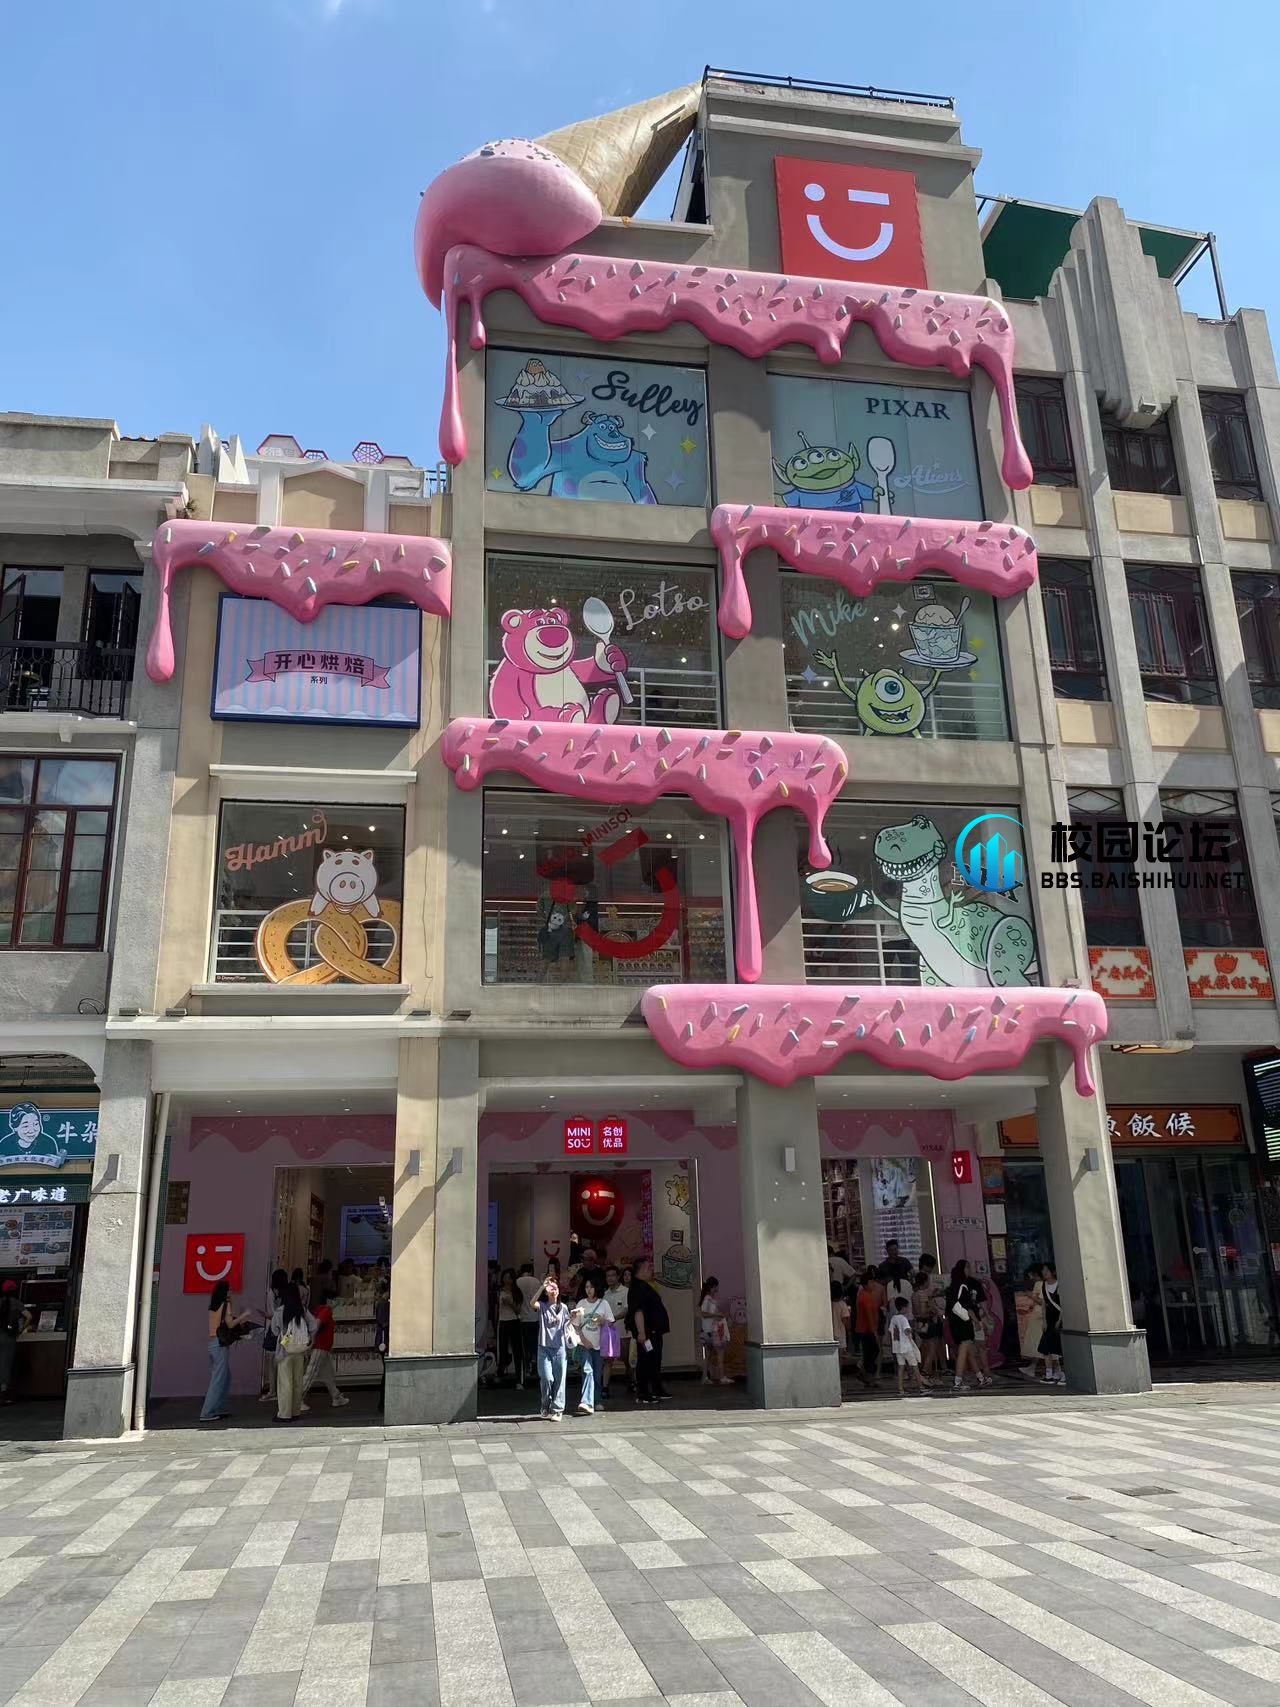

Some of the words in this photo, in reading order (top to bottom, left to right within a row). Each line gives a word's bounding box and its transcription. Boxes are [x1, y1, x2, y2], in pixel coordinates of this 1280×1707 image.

[592, 370, 703, 426] Sulley
[865, 397, 951, 420] PIXAR
[893, 463, 965, 491] Aliens
[619, 580, 710, 631] Lotso
[790, 588, 868, 645] Mike
[274, 653, 365, 675] 开心烘焙
[310, 676, 328, 685] 系列
[581, 807, 633, 848] MINISO!
[224, 808, 327, 872] Hamm
[56, 1120, 98, 1144] 牛杂
[567, 1127, 591, 1137] MINI
[603, 1126, 623, 1136] 名创
[603, 1137, 623, 1148] 优品
[0, 1186, 67, 1203] 老广味道
